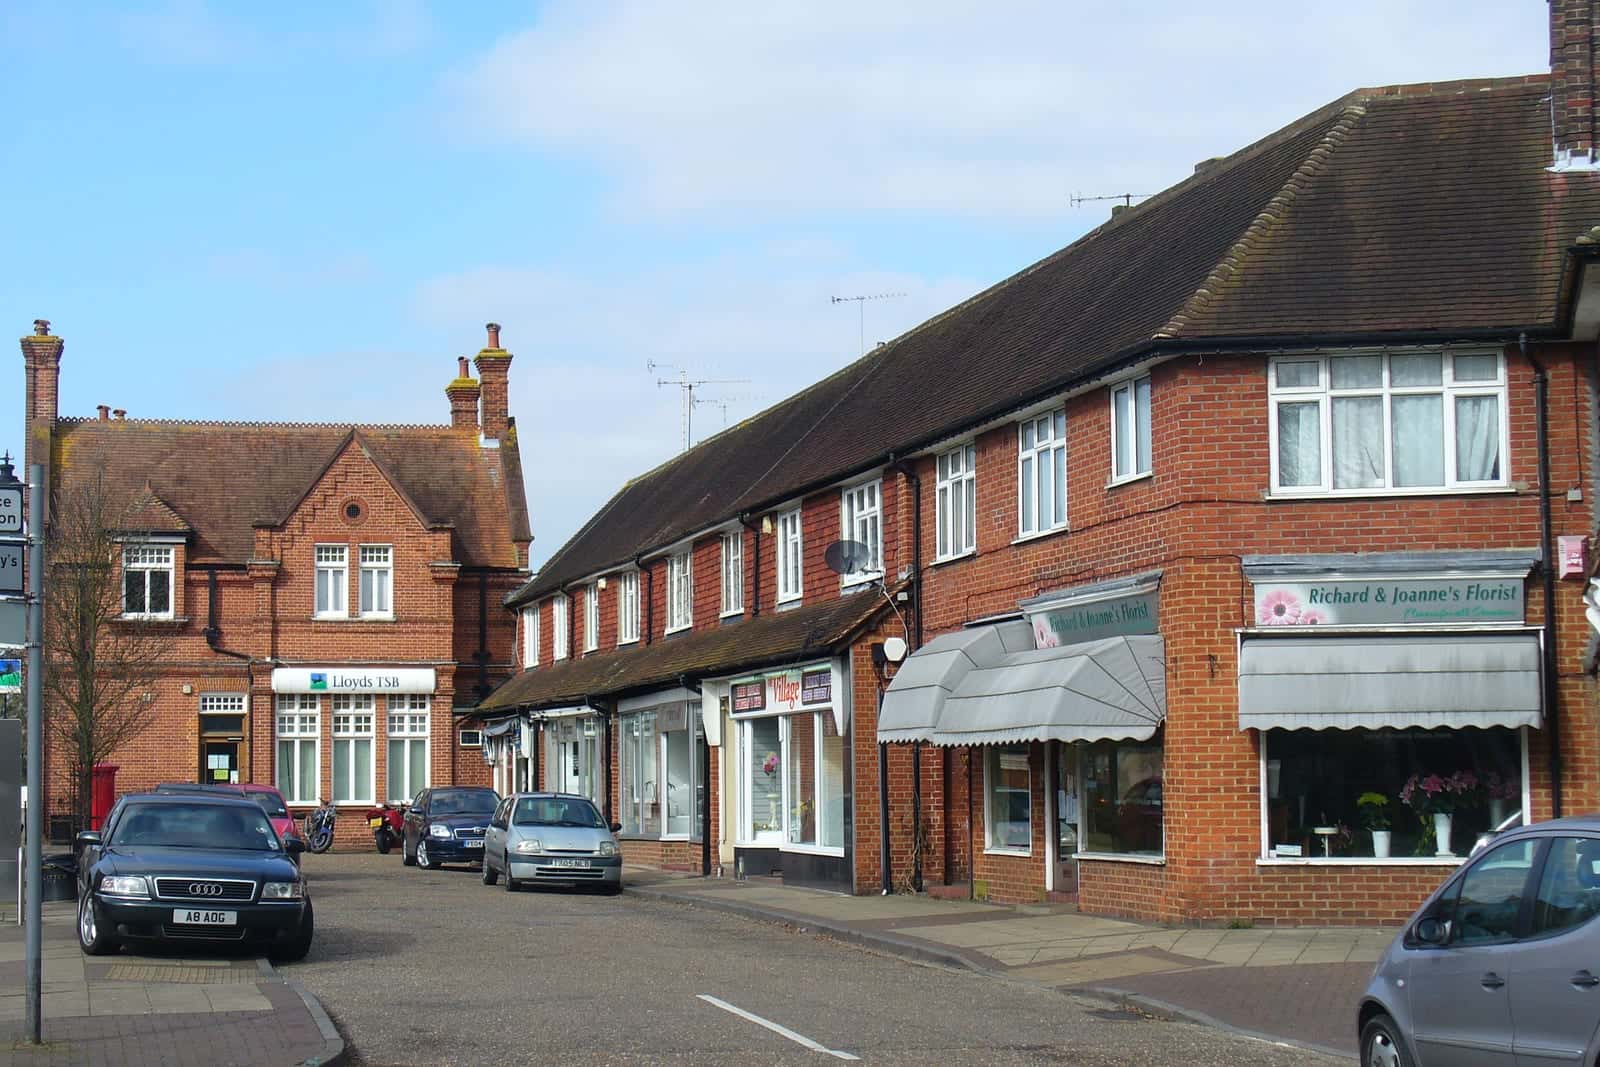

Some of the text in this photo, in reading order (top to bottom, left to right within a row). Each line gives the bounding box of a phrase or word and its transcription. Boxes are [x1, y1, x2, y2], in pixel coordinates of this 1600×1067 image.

[1309, 584, 1516, 605] Richard & Joanne's Florist
[1121, 600, 1149, 621] Florist
[333, 676, 400, 691] Lloyds TSB
[773, 674, 800, 709] Village
[186, 911, 200, 922] A8
